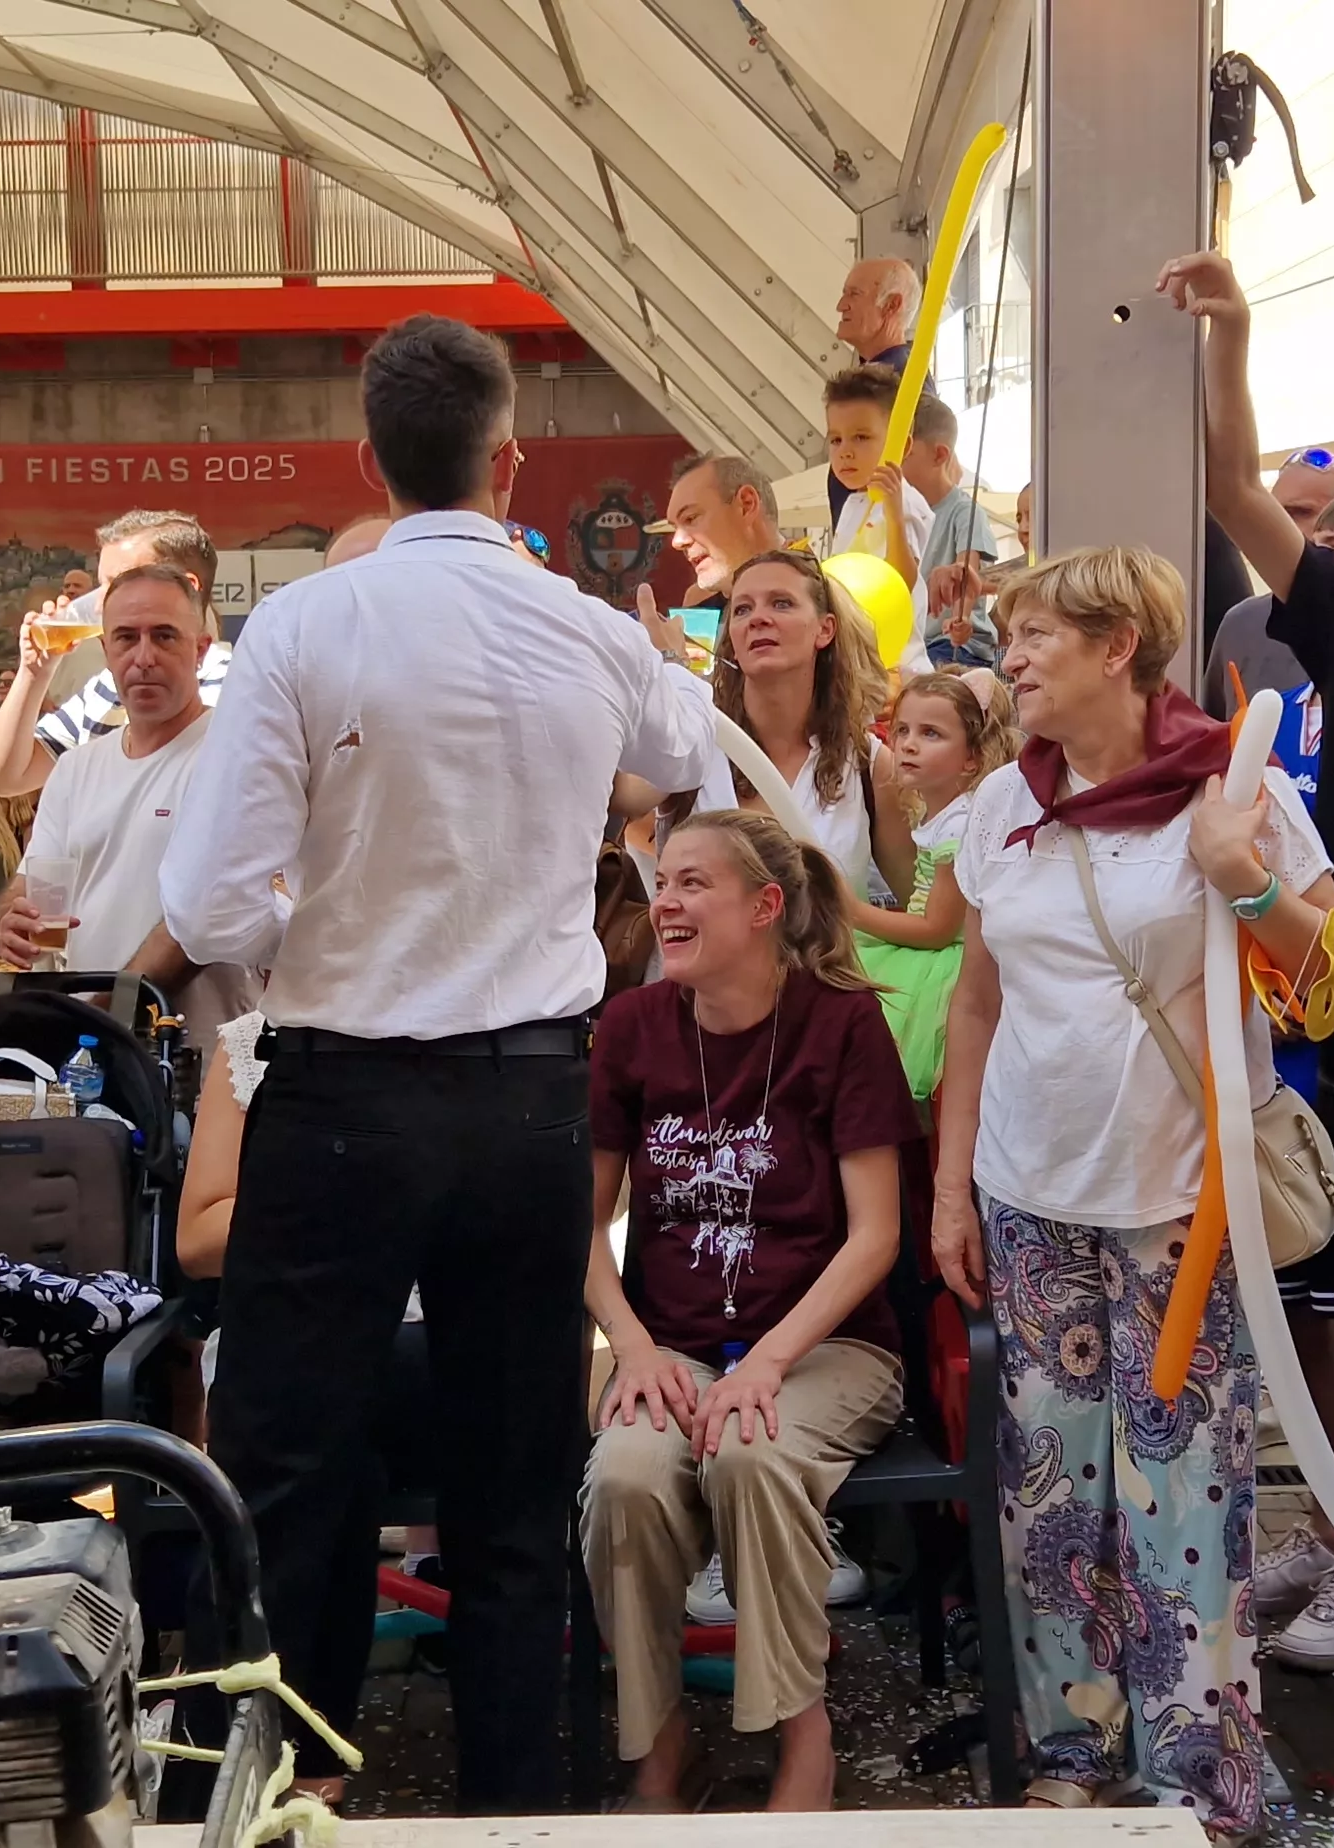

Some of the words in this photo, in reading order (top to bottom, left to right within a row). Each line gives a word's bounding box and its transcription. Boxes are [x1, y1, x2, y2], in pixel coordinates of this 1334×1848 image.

[25, 457, 190, 483] FIESTAS
[203, 453, 297, 482] 2025
[212, 582, 246, 603] ER
[651, 1113, 774, 1146] Almudévar
[647, 1146, 698, 1170] Fiestas
